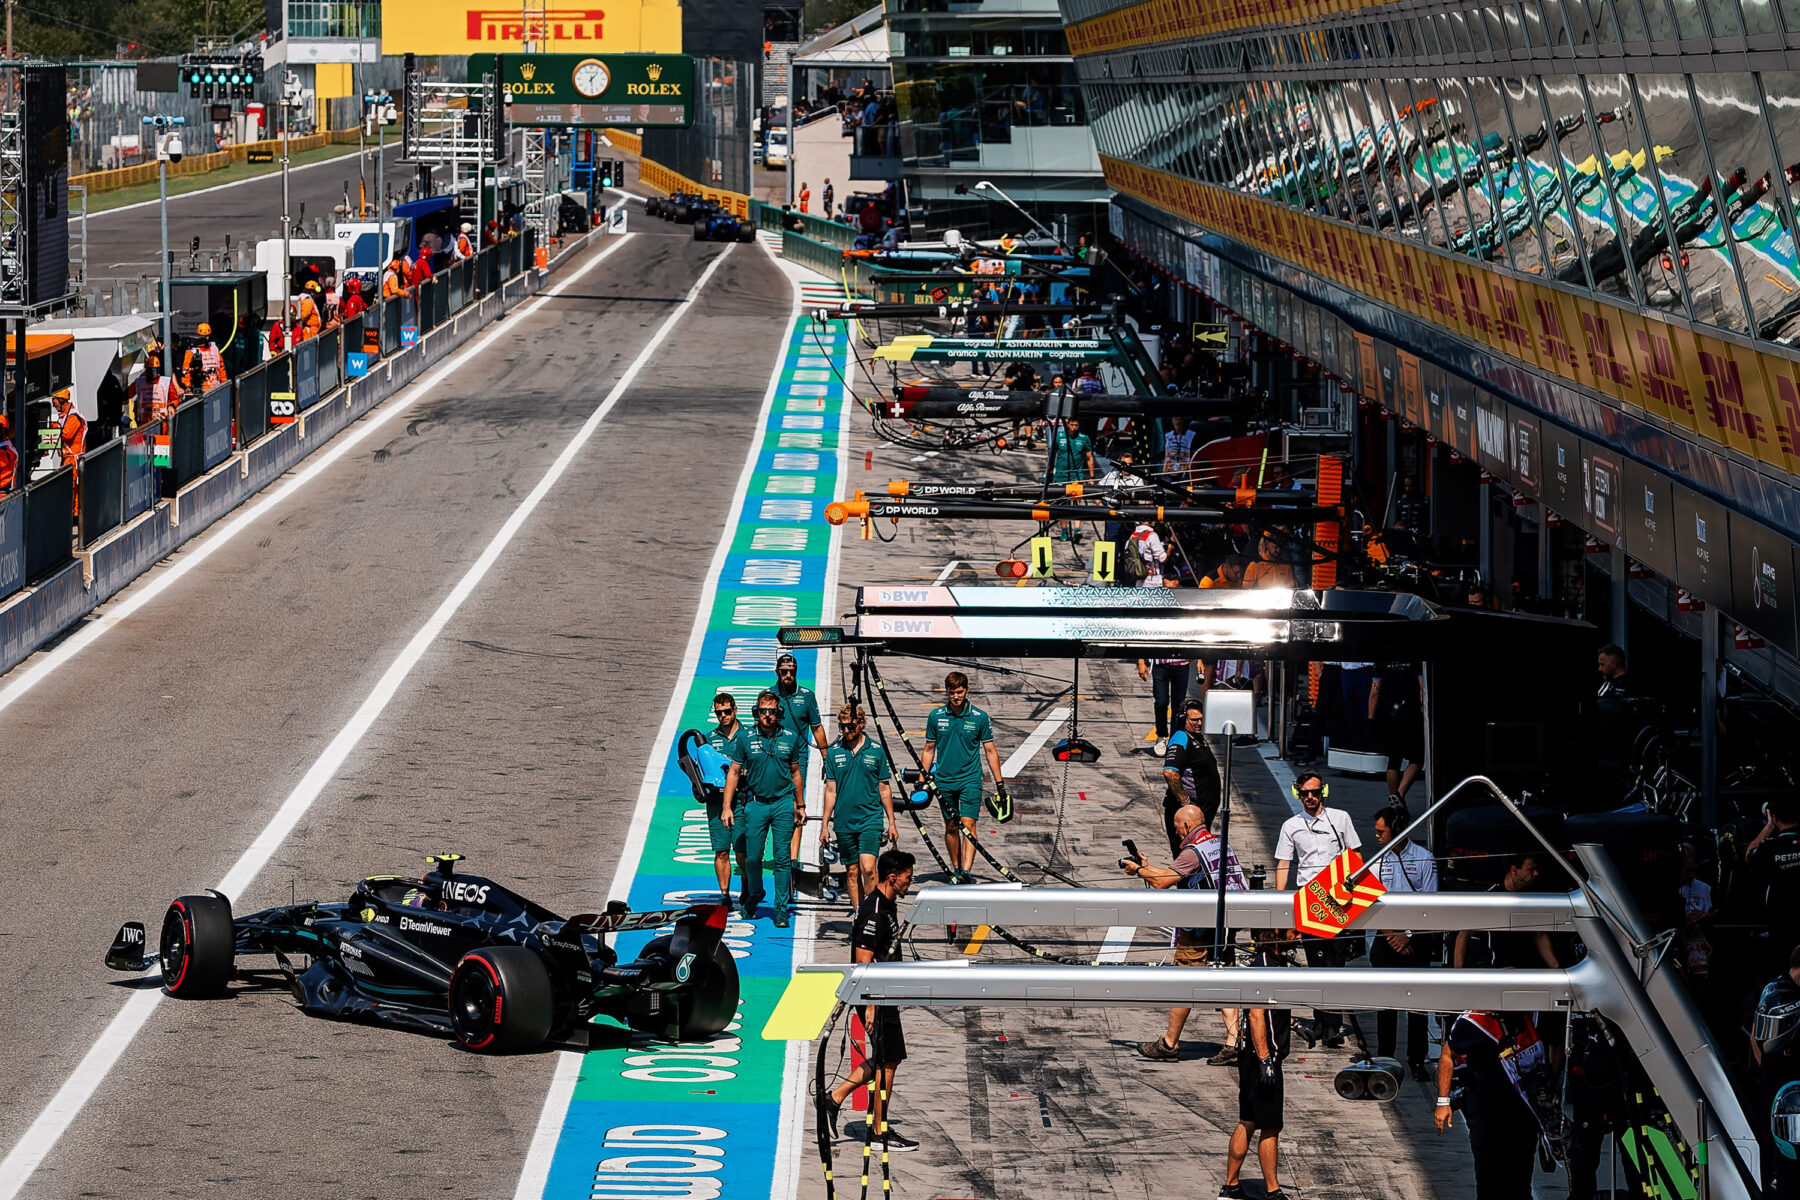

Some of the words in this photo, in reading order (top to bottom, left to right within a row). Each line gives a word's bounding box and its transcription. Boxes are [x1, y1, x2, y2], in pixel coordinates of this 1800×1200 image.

[467, 10, 605, 40] PIRELLI
[627, 83, 682, 95] ROLEX
[403, 332, 414, 340] W
[985, 350, 1011, 358] ASTON
[1012, 350, 1043, 358] MARTIN
[352, 359, 363, 369] W
[957, 403, 975, 414] Alfa
[975, 403, 1001, 411] Romeo
[939, 486, 976, 494] WORLD
[901, 507, 939, 515] WORLD
[893, 591, 929, 601] BWT
[893, 620, 932, 633] BWT
[441, 881, 490, 904] INEOS
[1309, 880, 1349, 924] BRAKES
[1310, 903, 1328, 921] ON
[408, 919, 451, 936] TeamViewer
[123, 927, 144, 944] IWC
[340, 942, 362, 958] PETRONAS
[589, 1124, 729, 1200] aram
